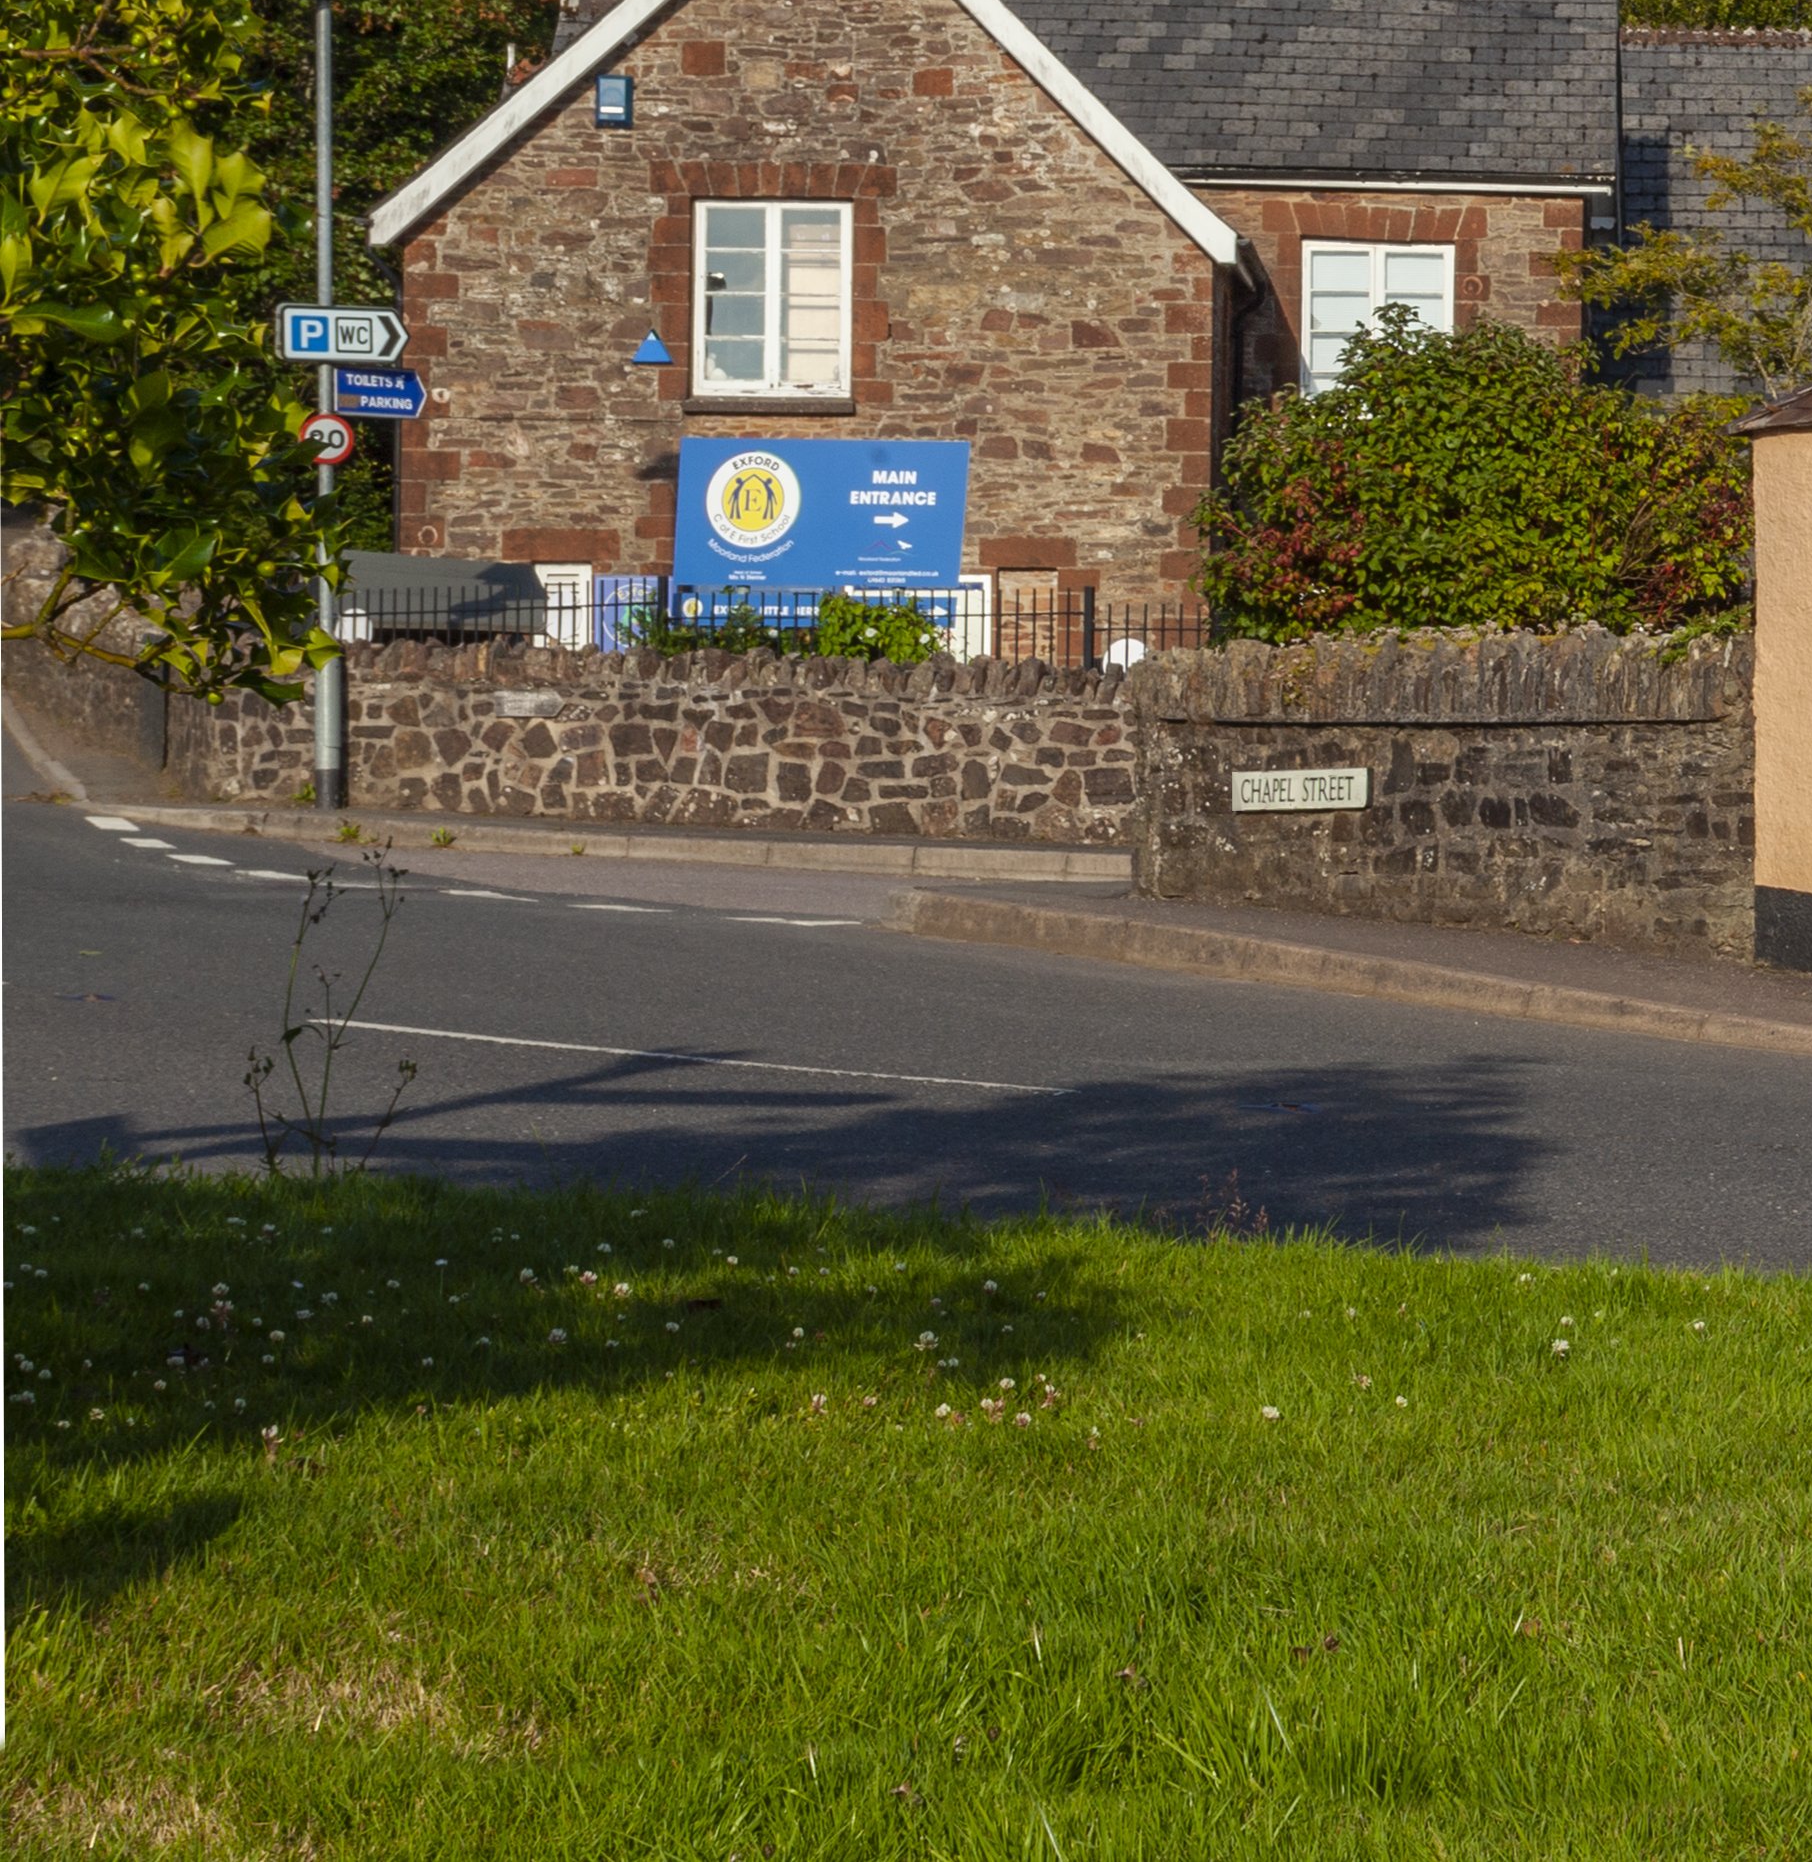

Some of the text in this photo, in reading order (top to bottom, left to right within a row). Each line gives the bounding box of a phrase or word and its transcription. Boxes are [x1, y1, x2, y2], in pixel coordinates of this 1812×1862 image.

[301, 320, 368, 348] P WC
[346, 374, 393, 388] TOILETS
[360, 395, 413, 410] PARKING
[732, 456, 780, 471] EXFORD
[872, 470, 917, 485] MAIN
[744, 489, 762, 511] E
[849, 491, 937, 506] ENTRANCE
[713, 513, 791, 544] C of E First School
[708, 538, 795, 563] Moorland Federation
[1241, 776, 1355, 803] CHAPEL STREET
